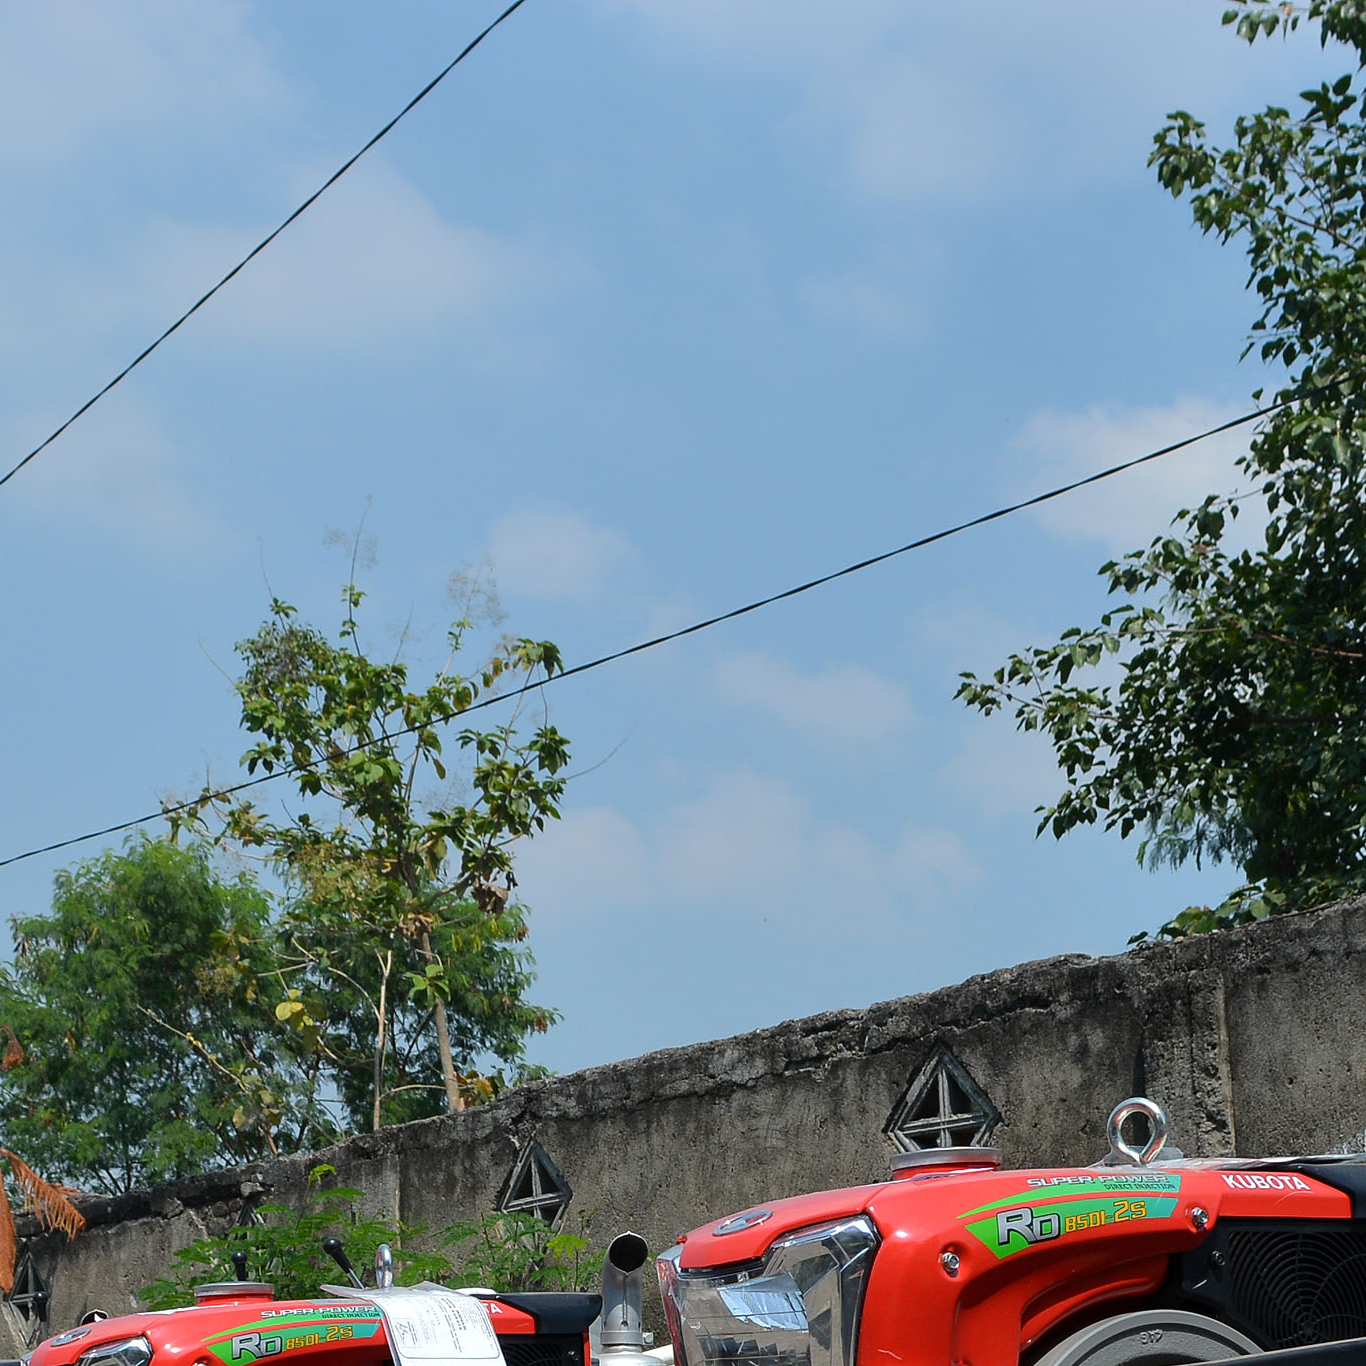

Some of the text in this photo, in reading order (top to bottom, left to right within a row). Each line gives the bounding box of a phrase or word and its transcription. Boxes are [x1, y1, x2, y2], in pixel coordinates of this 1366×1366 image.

[1026, 1174, 1171, 1188] SUPER POWER
[1221, 1174, 1312, 1191] KUBOTA
[261, 1306, 378, 1318] SUPER POWER
